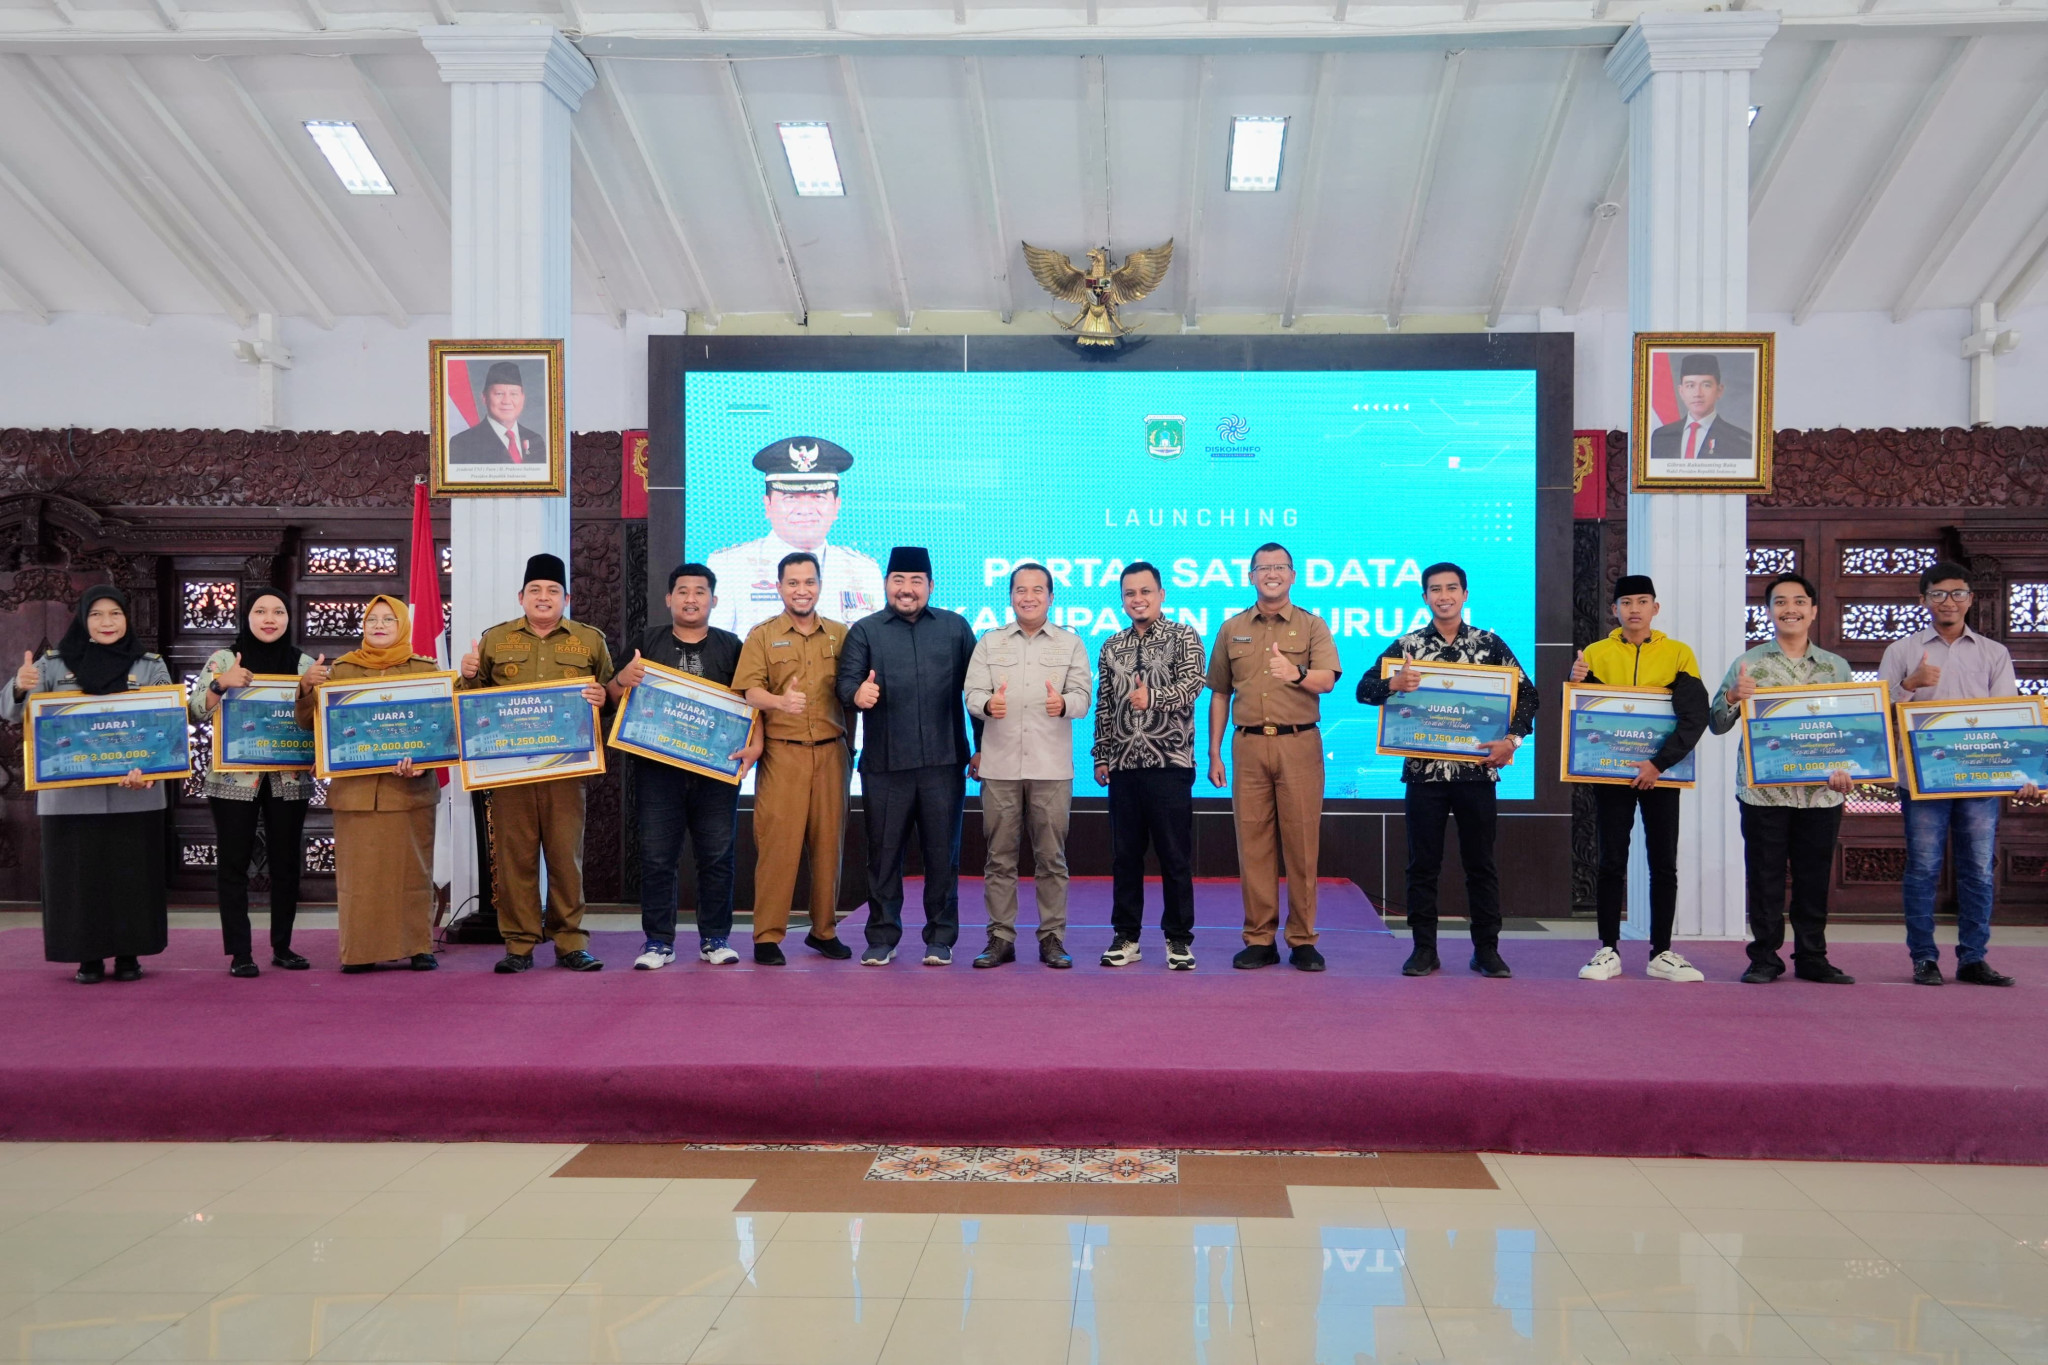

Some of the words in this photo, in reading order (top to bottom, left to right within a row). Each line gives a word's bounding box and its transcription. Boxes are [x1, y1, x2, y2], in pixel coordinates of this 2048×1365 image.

[1105, 508, 1298, 527] LAUNCHING
[985, 557, 1146, 588] PRTA
[1172, 557, 1251, 588] SAT
[1305, 558, 1424, 588] DATA
[557, 645, 588, 654] KADES
[507, 696, 542, 706] JUARA
[271, 709, 295, 718] JUA
[498, 706, 549, 717] HARAPAN
[675, 701, 706, 717] JUARA
[1427, 704, 1460, 714] JUARA
[1461, 706, 1466, 715] 1
[372, 711, 406, 721] JUARA
[408, 710, 414, 719] 3
[663, 706, 709, 727] HARAPAN
[709, 721, 715, 730] 2
[90, 720, 128, 731] JUARA
[130, 720, 136, 728] 1
[1798, 721, 1833, 730] JUARA
[657, 734, 670, 744] RP
[1413, 732, 1426, 741] RP
[1614, 729, 1646, 739] JUARA
[1647, 731, 1653, 740] 3
[1790, 731, 1837, 742] Harapan
[1838, 730, 1843, 739] 1
[1963, 732, 1998, 741] JUARA
[256, 739, 270, 748] RP
[272, 739, 315, 748] 2.500.00
[358, 744, 371, 753] RP
[495, 739, 508, 748] RP
[1954, 741, 2001, 752] Harapan
[2003, 741, 2010, 750] 2
[73, 754, 88, 763] RP
[1600, 758, 1612, 767] RP
[1783, 763, 1797, 772] RP
[1954, 772, 1968, 781] RP
